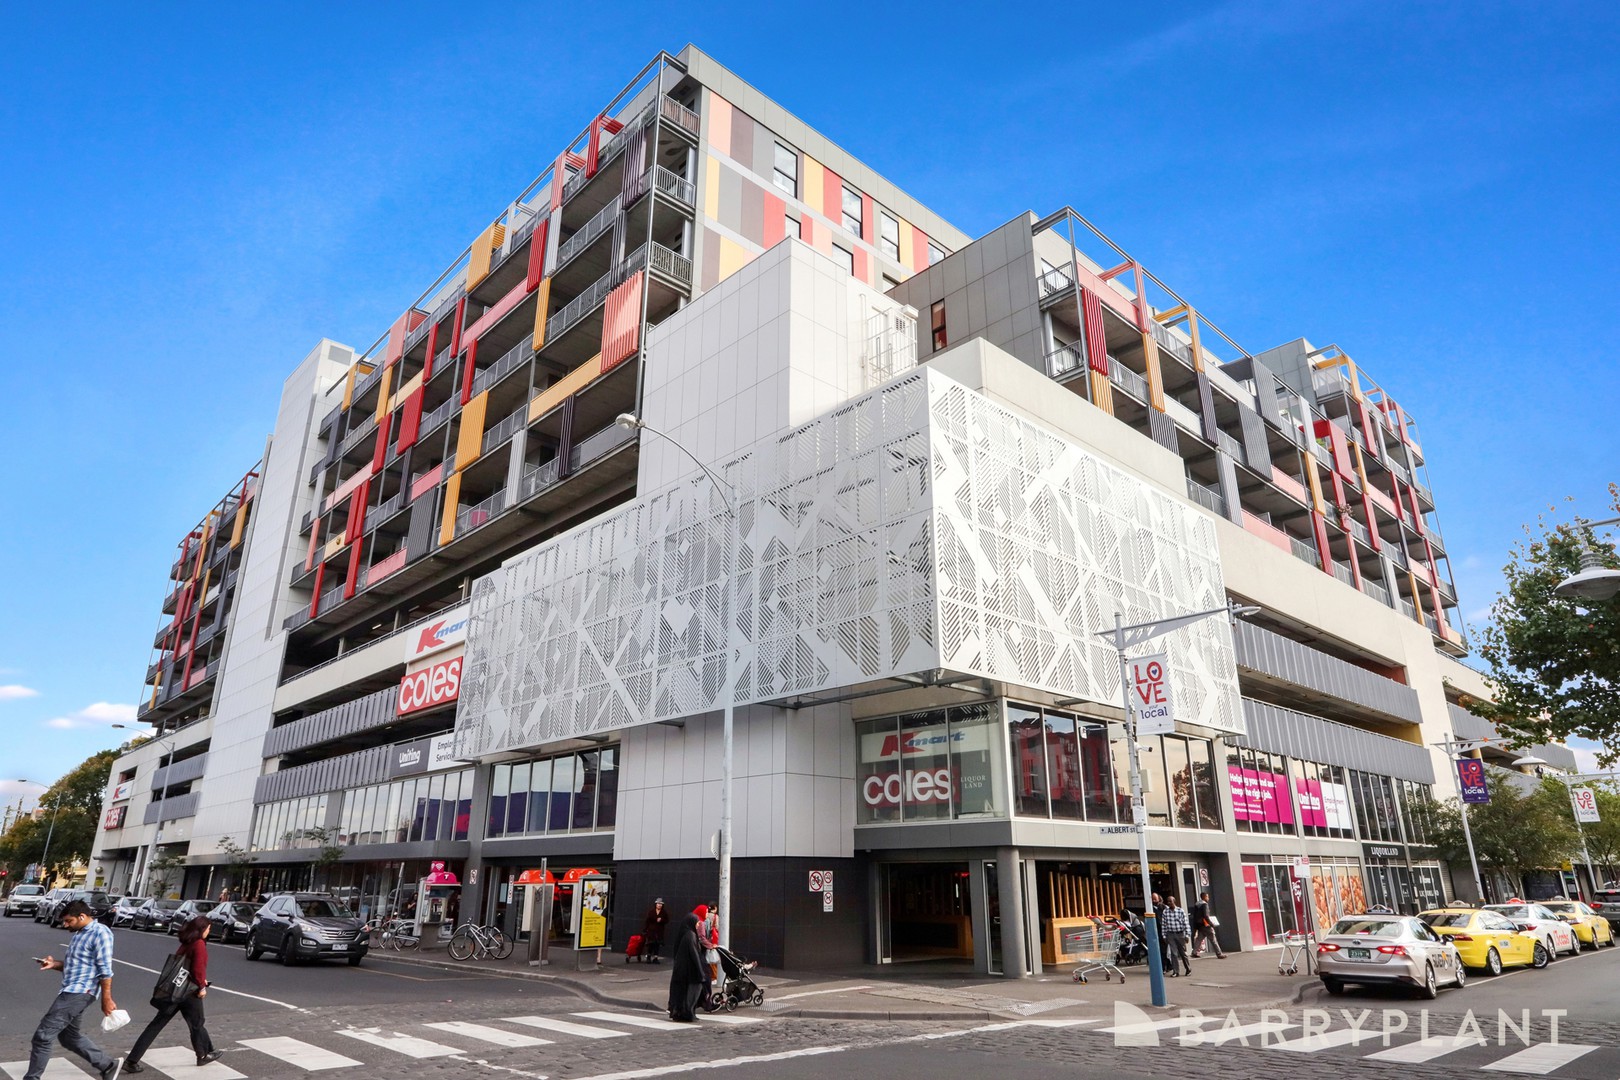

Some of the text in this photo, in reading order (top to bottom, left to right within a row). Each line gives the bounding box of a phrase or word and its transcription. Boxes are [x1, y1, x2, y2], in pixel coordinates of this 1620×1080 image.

[416, 619, 468, 654] Kmar
[399, 661, 460, 712] coles
[1140, 706, 1168, 719] local
[880, 731, 966, 757] Kmart
[399, 747, 421, 766] Uniting
[863, 769, 953, 805] coles
[961, 774, 986, 783] LIQUOR
[1107, 826, 1129, 834] ALBERT
[1370, 846, 1399, 857] LIQUORLAND
